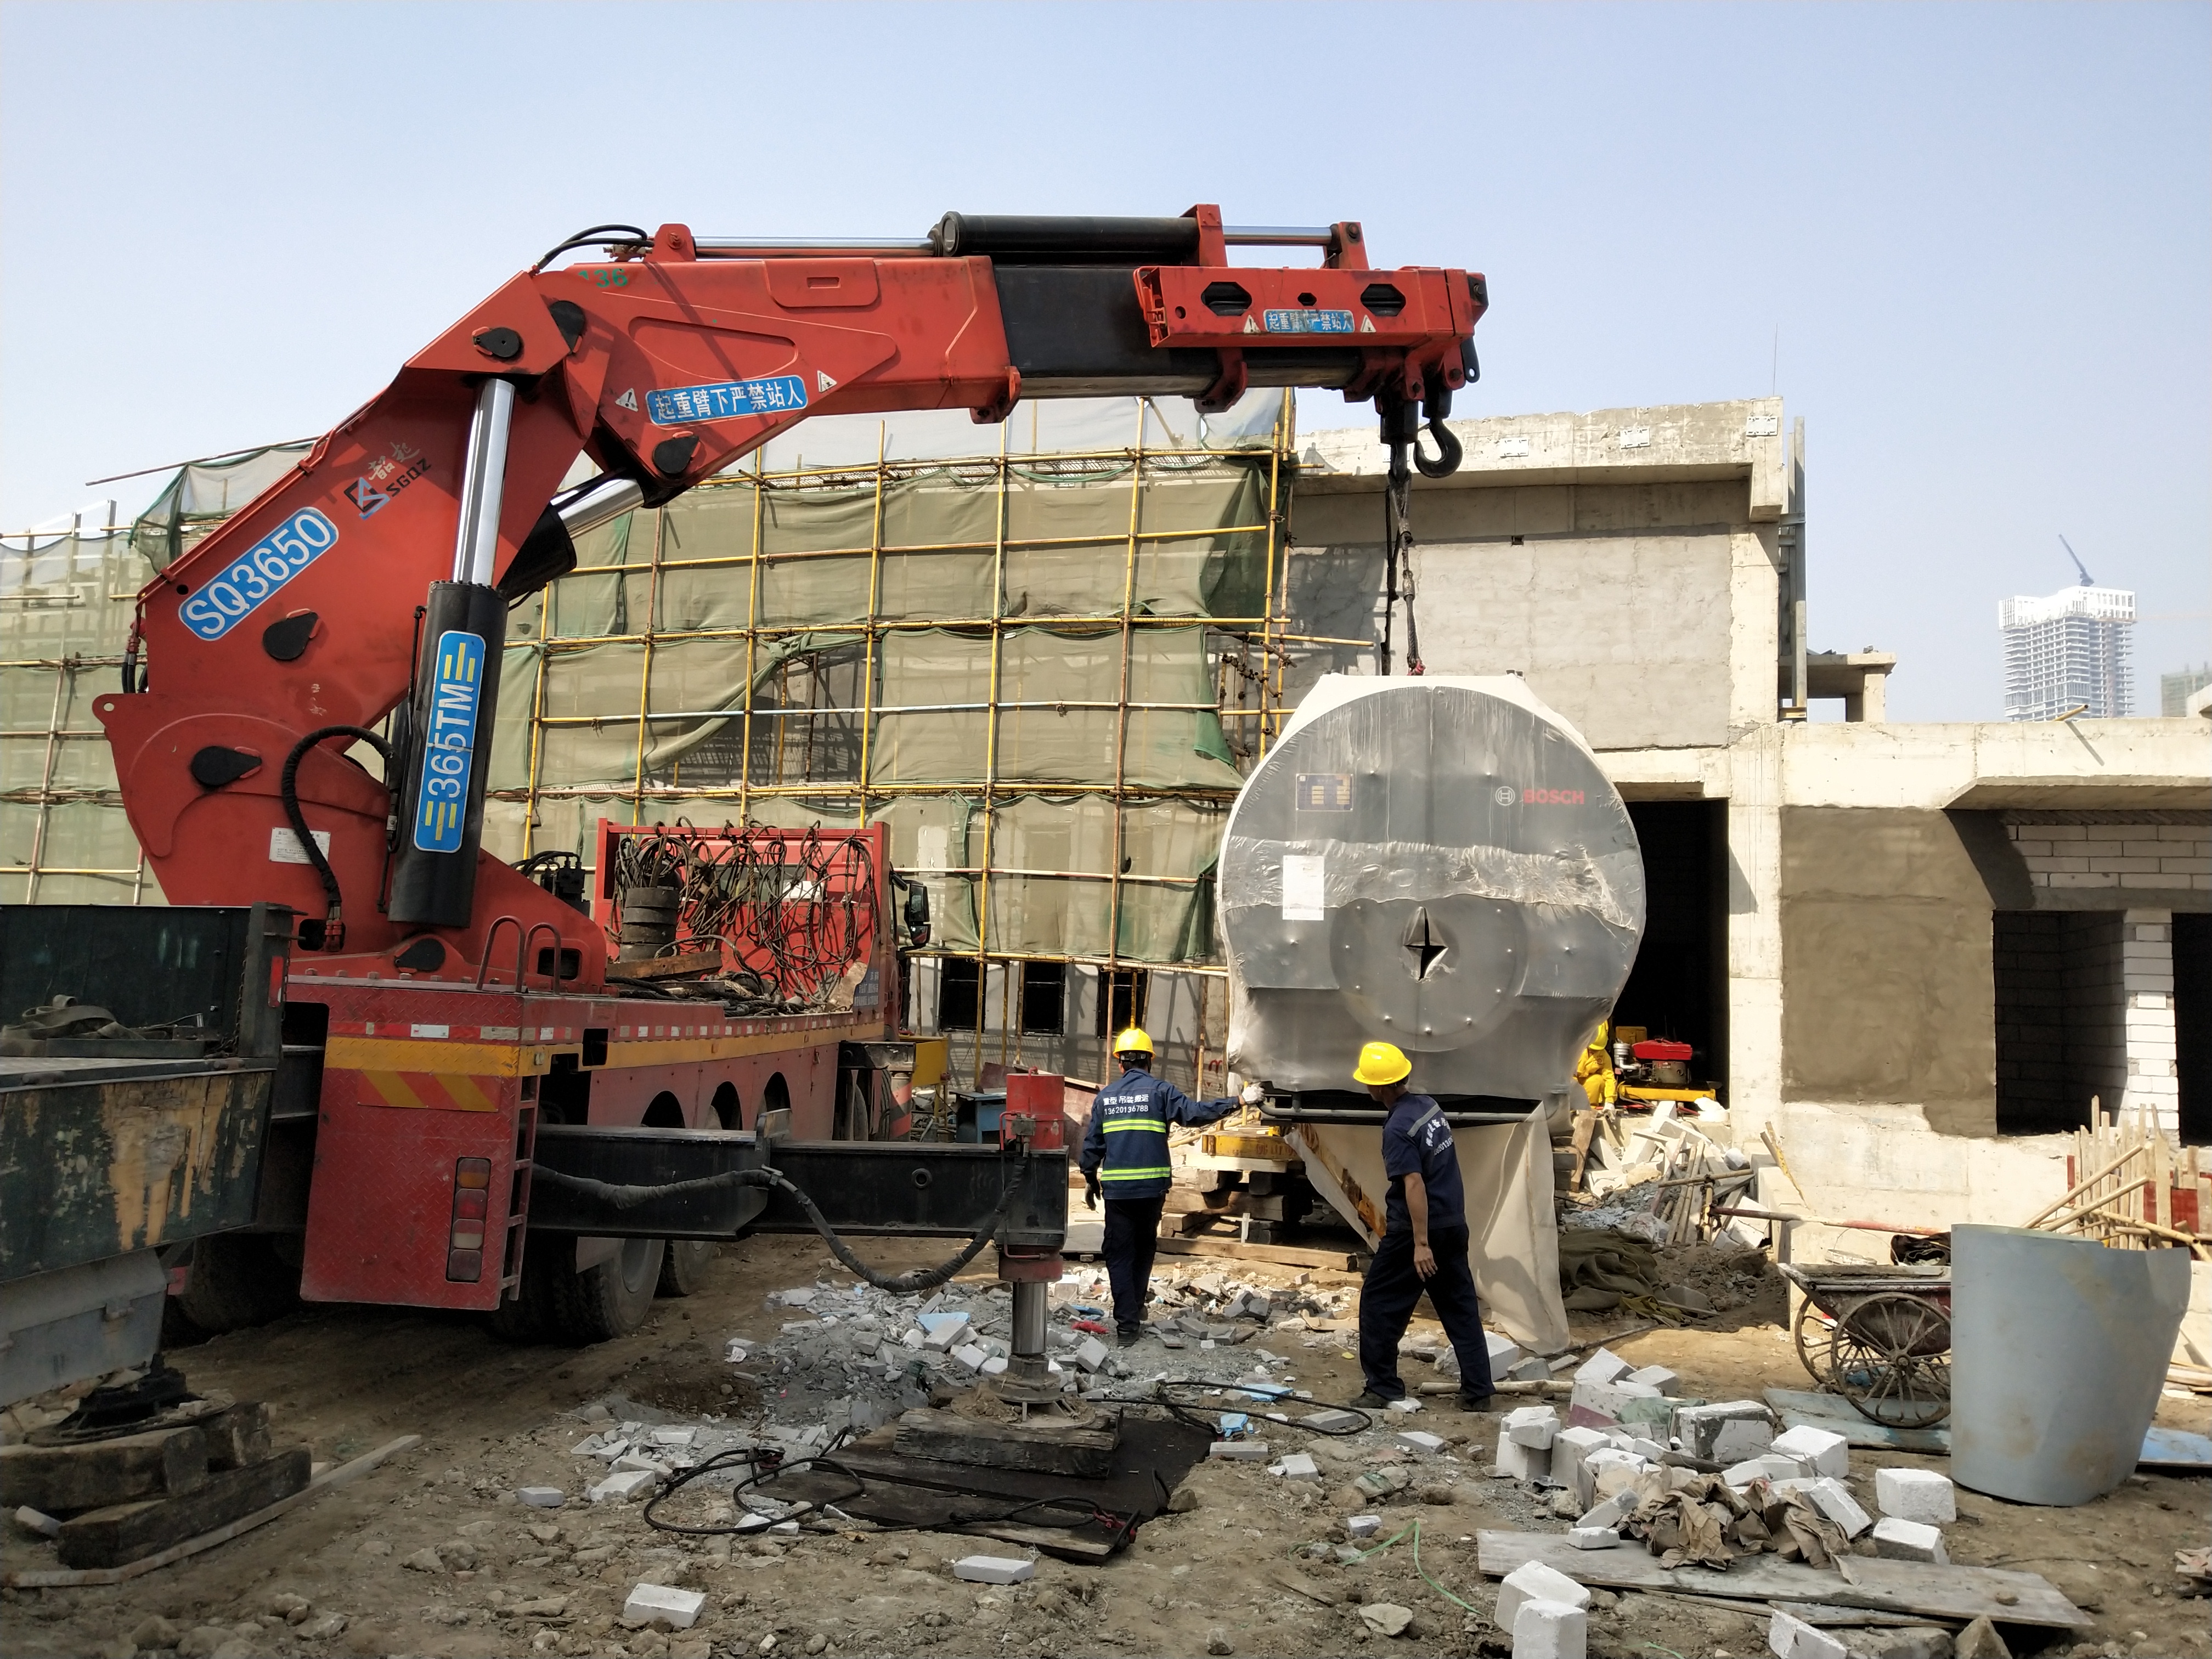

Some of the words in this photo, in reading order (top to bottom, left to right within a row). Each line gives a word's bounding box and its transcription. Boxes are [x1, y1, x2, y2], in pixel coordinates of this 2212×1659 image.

[655, 379, 804, 421] 起重臂下严禁站人
[385, 458, 432, 497] SGQZ
[185, 513, 331, 635] SQ3650
[428, 684, 475, 798] 365TM
[1523, 789, 1585, 805] BOSCH
[1104, 1105, 1149, 1115] 13620136788
